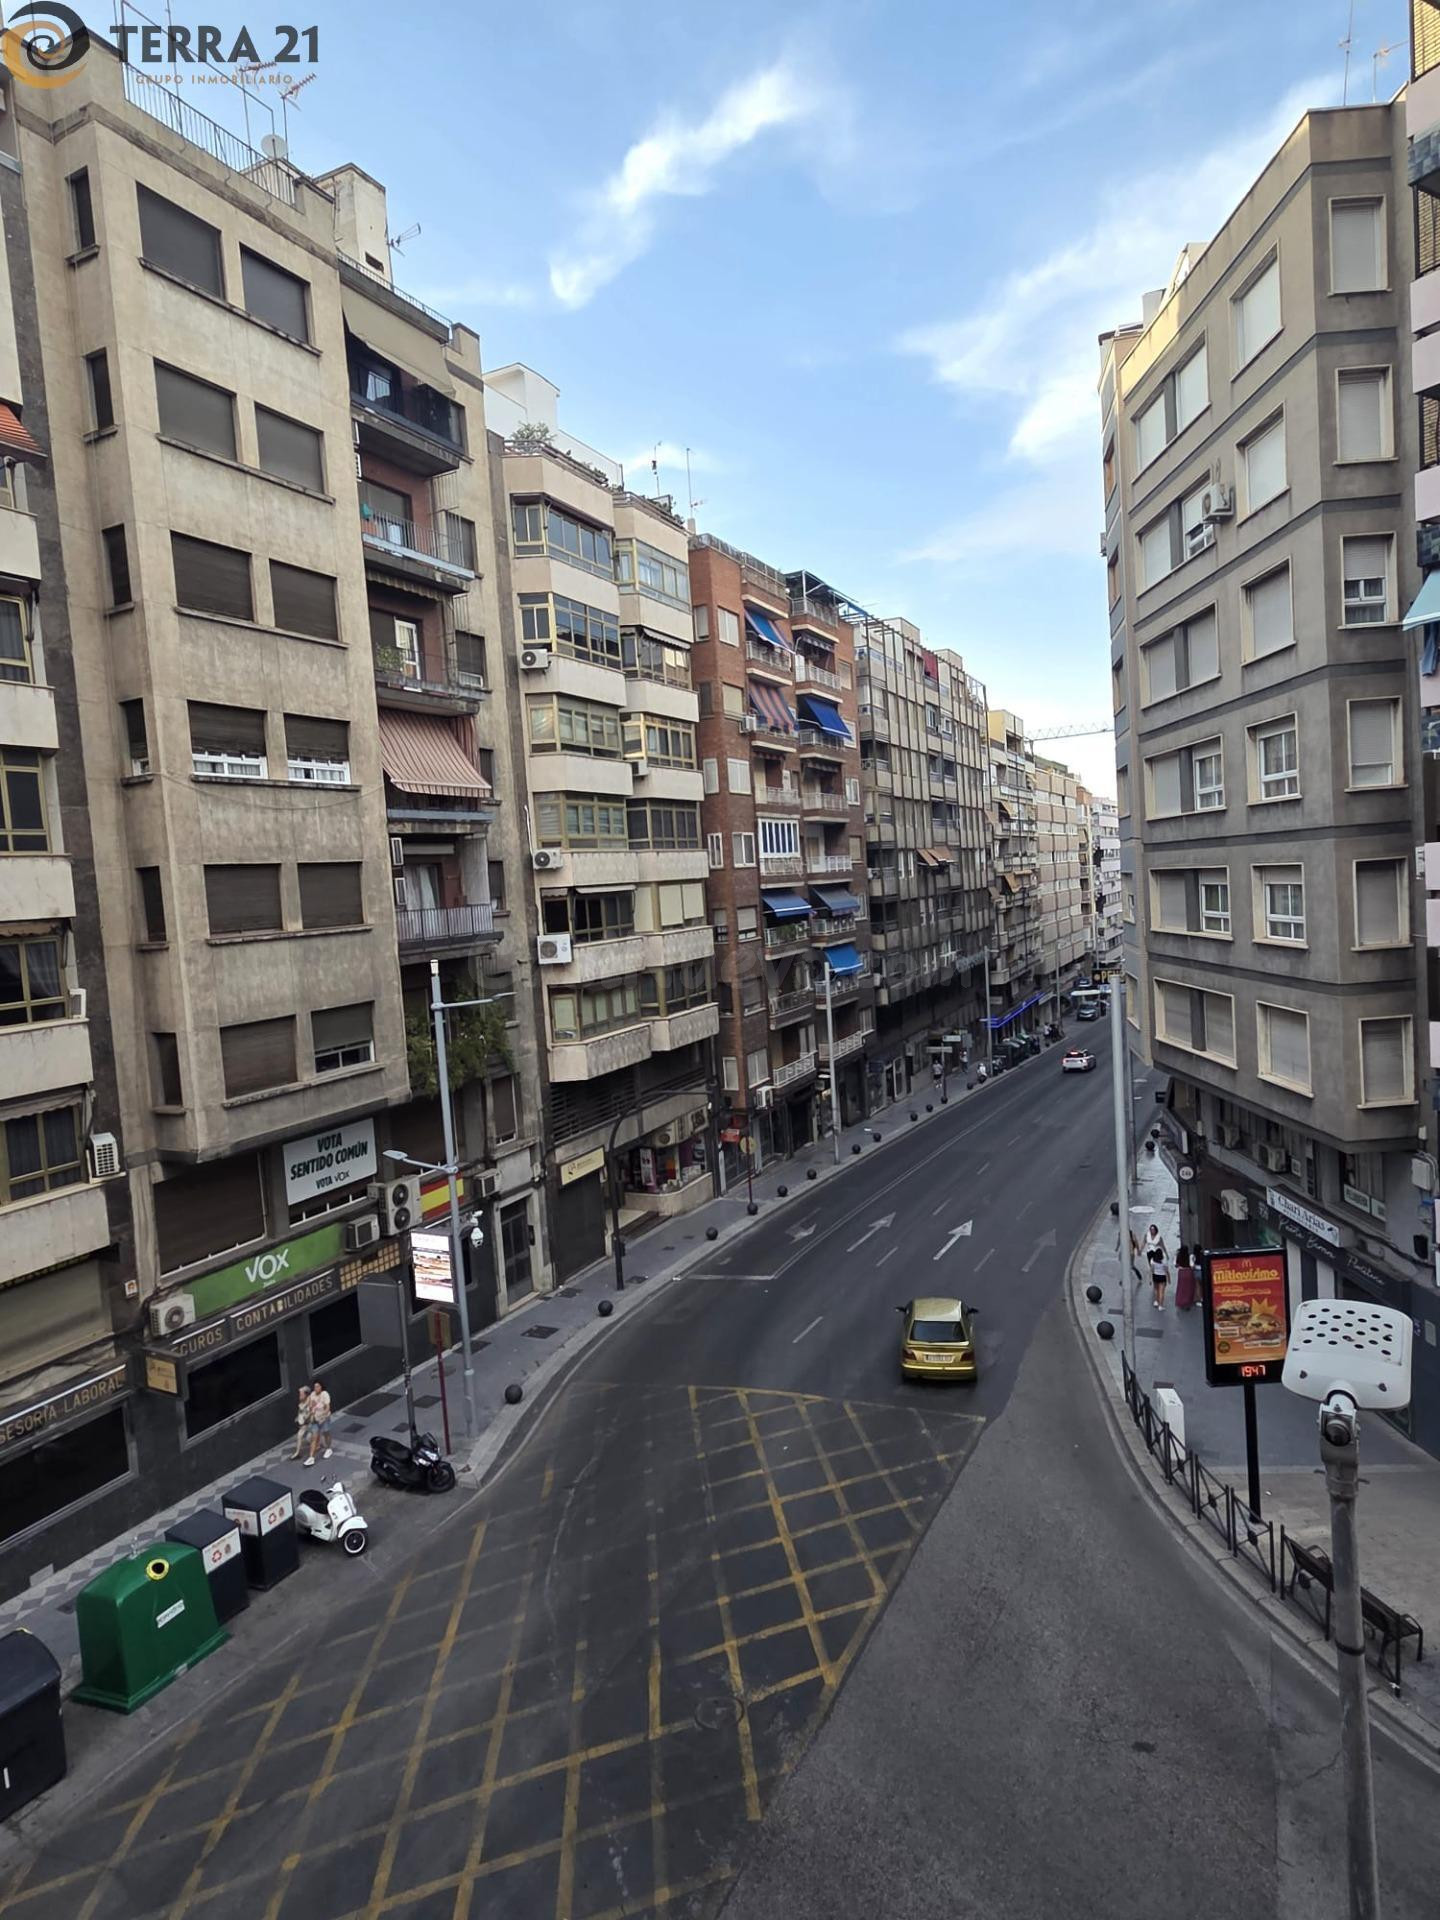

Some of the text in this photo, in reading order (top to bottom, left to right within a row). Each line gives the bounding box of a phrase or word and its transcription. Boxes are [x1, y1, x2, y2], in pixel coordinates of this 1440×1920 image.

[290, 1141, 368, 1181] SENTIDO COMÚN
[317, 1133, 342, 1153] VOTA
[316, 1176, 333, 1189] VOTA
[244, 1248, 289, 1283] VOX
[171, 1276, 334, 1356] GUROS CONTABILIDADES
[0, 1378, 124, 1444] SESORÍA LABORAL
